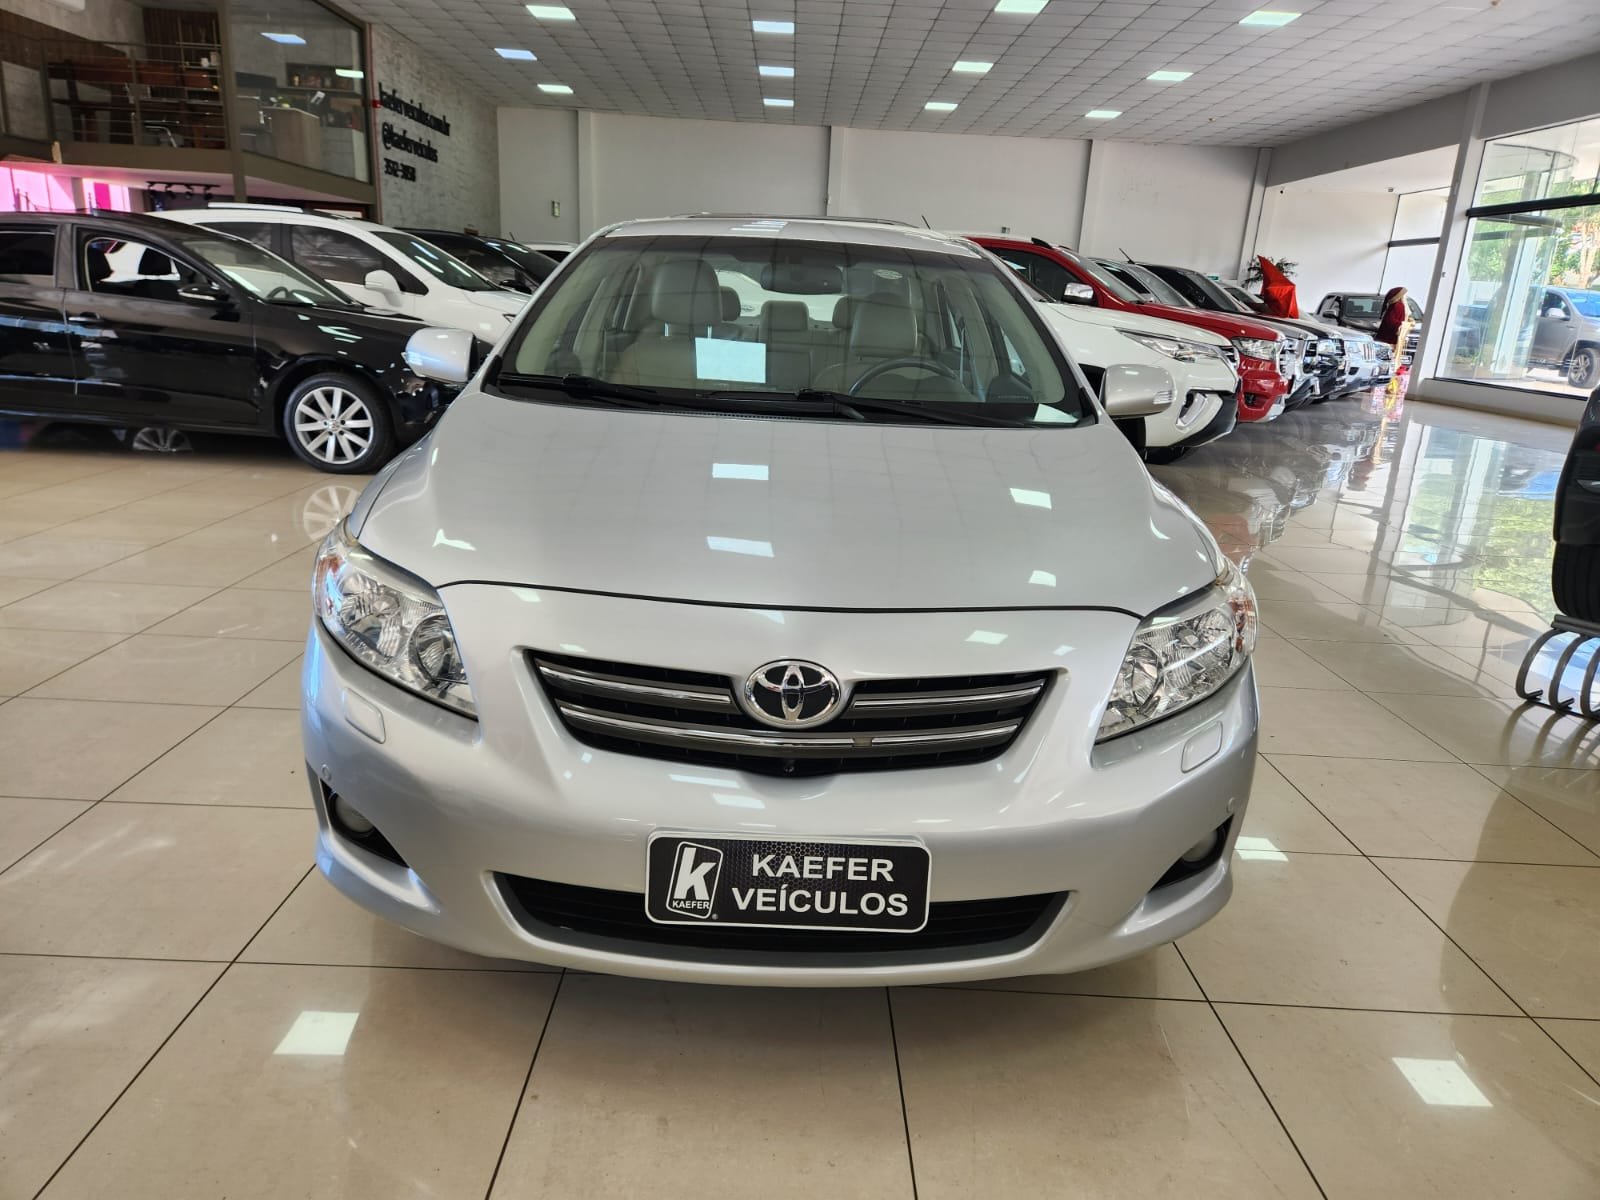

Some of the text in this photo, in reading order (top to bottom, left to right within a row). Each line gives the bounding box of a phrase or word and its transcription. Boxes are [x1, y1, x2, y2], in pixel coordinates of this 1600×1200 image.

[752, 853, 895, 883] KAEFER
[672, 900, 711, 910] KAEFER
[731, 883, 909, 917] VEÍCULOS
